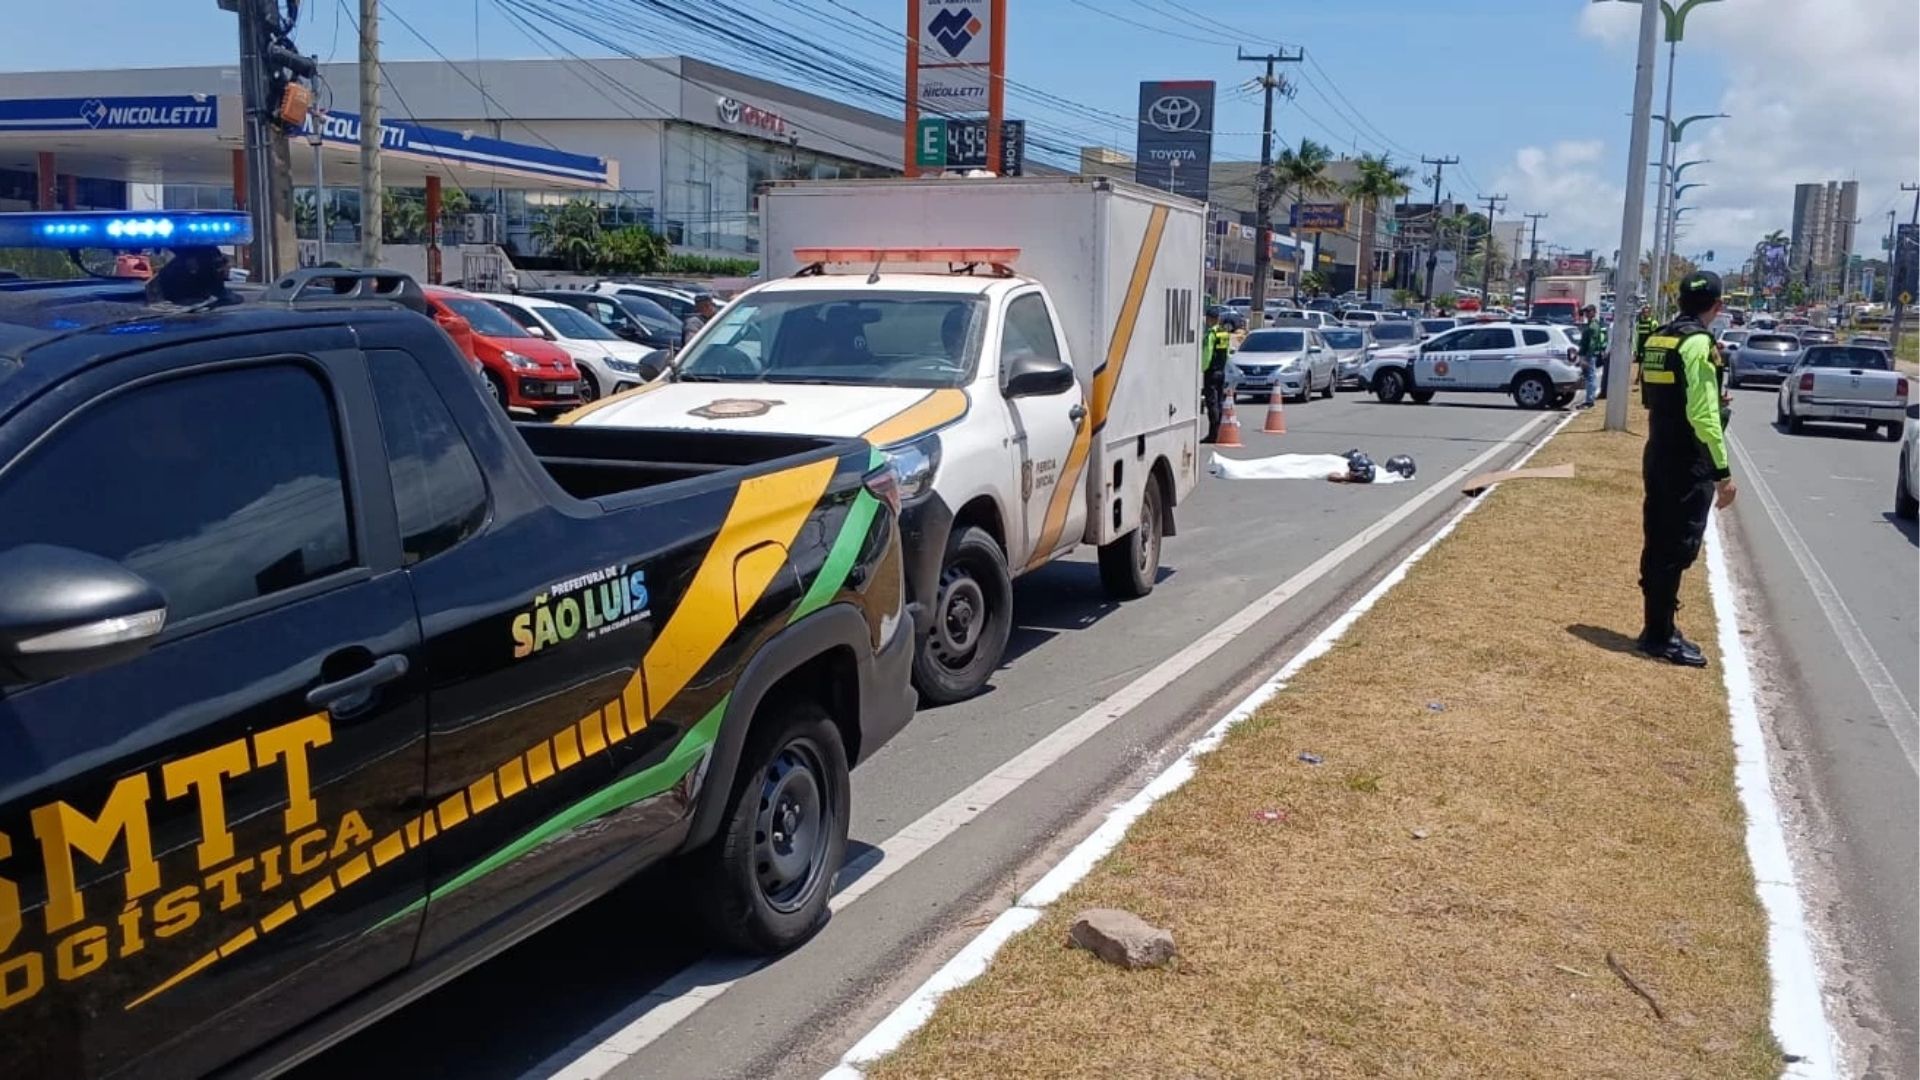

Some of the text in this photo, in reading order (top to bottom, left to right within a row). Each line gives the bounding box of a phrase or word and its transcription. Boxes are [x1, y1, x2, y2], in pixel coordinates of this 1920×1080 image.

[923, 87, 984, 97] NICOLLETTI
[108, 106, 212, 125] NICOLLETTI
[924, 126, 939, 154] E
[947, 126, 987, 161] 4,99
[1150, 150, 1196, 160] TOYOTA
[1164, 288, 1195, 346] IML
[551, 565, 618, 597] PREFEITURA DE
[511, 564, 648, 658] SÃO LUÍS
[0, 810, 373, 1011] OGÍSTICA
